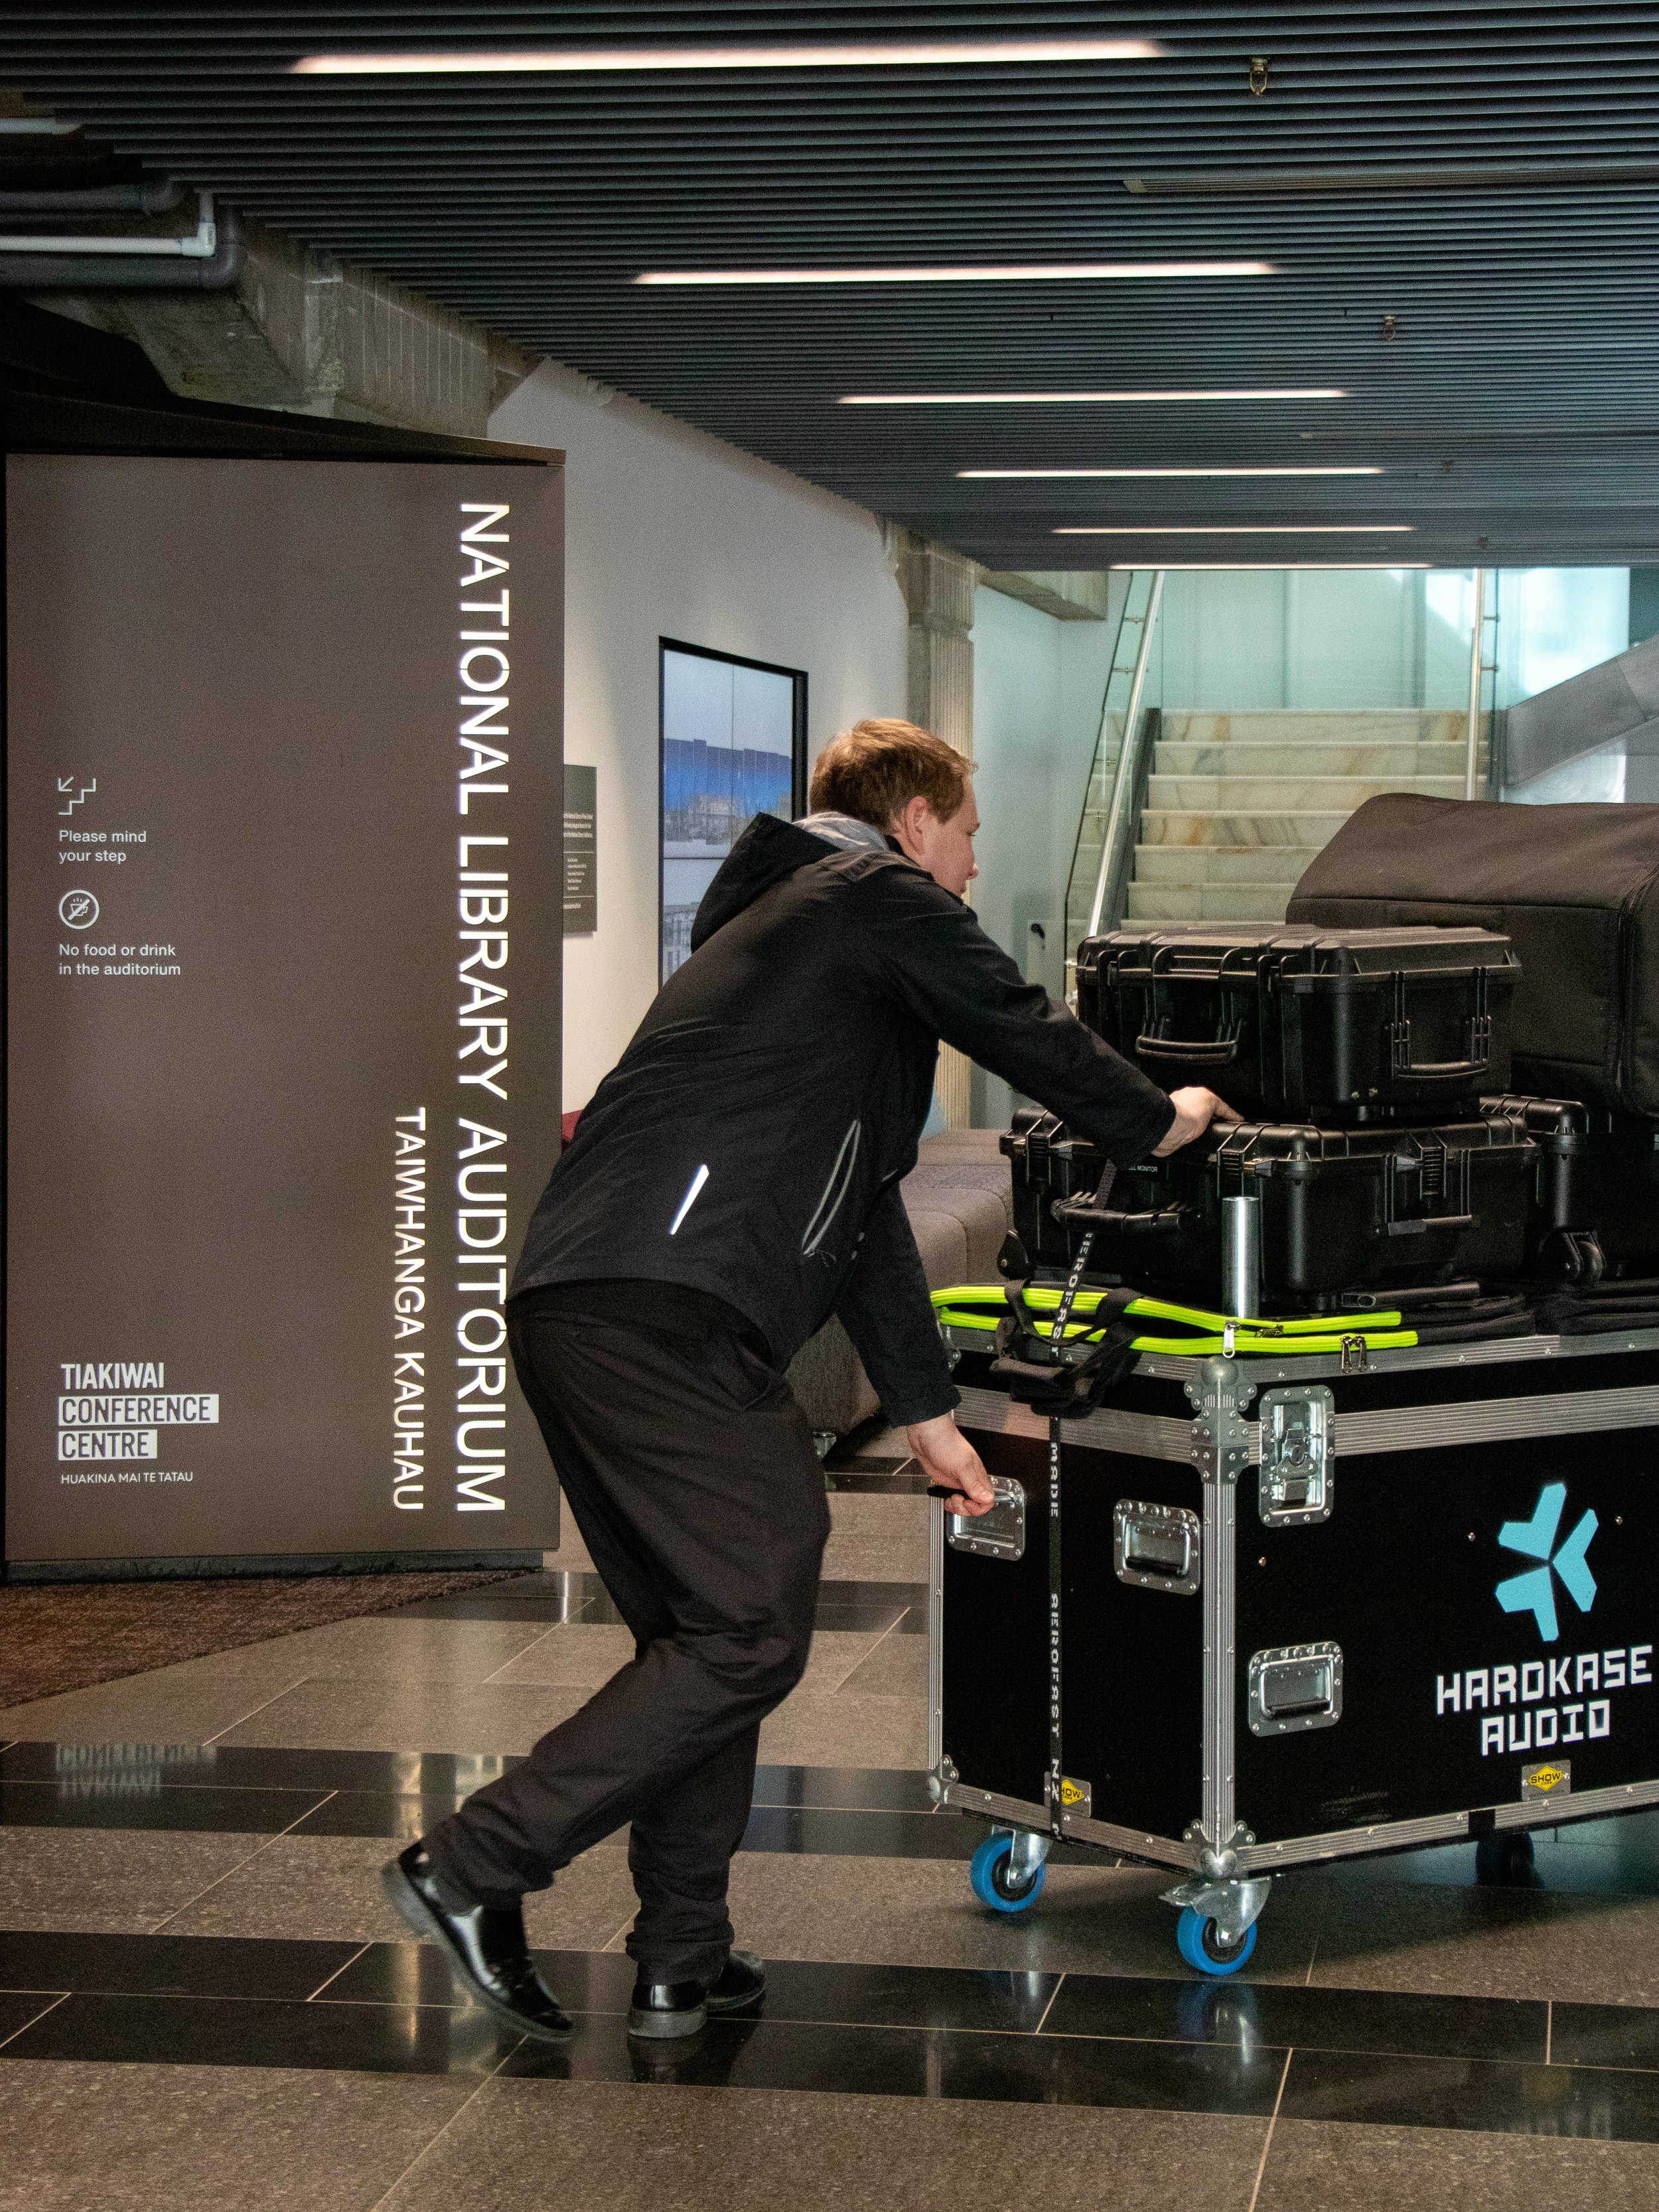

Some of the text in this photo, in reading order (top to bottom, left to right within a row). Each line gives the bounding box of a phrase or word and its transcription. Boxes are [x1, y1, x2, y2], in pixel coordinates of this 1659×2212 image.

[59, 830, 147, 843] Please mind
[59, 850, 127, 865] your step
[59, 944, 176, 956] No food or drink
[59, 963, 181, 976] in the auditorium
[456, 503, 510, 1512] NATIONAL LIBRARY AUDITORIUM
[392, 1106, 426, 1510] TAIWHANGA KAUHAU
[60, 1362, 165, 1390] TIAKIWAI
[61, 1396, 211, 1424] CONFERENCE
[61, 1432, 149, 1459] CENTRE
[61, 1471, 193, 1484] HUAKINA MAI TE TATAU
[1050, 1442, 1059, 1517] MADE
[1050, 1593, 1059, 1738] AEROFAST
[1436, 1645, 1653, 1715] HARDKASE
[1481, 1698, 1611, 1756] AUDIO
[1530, 1773, 1561, 1784] SHOW
